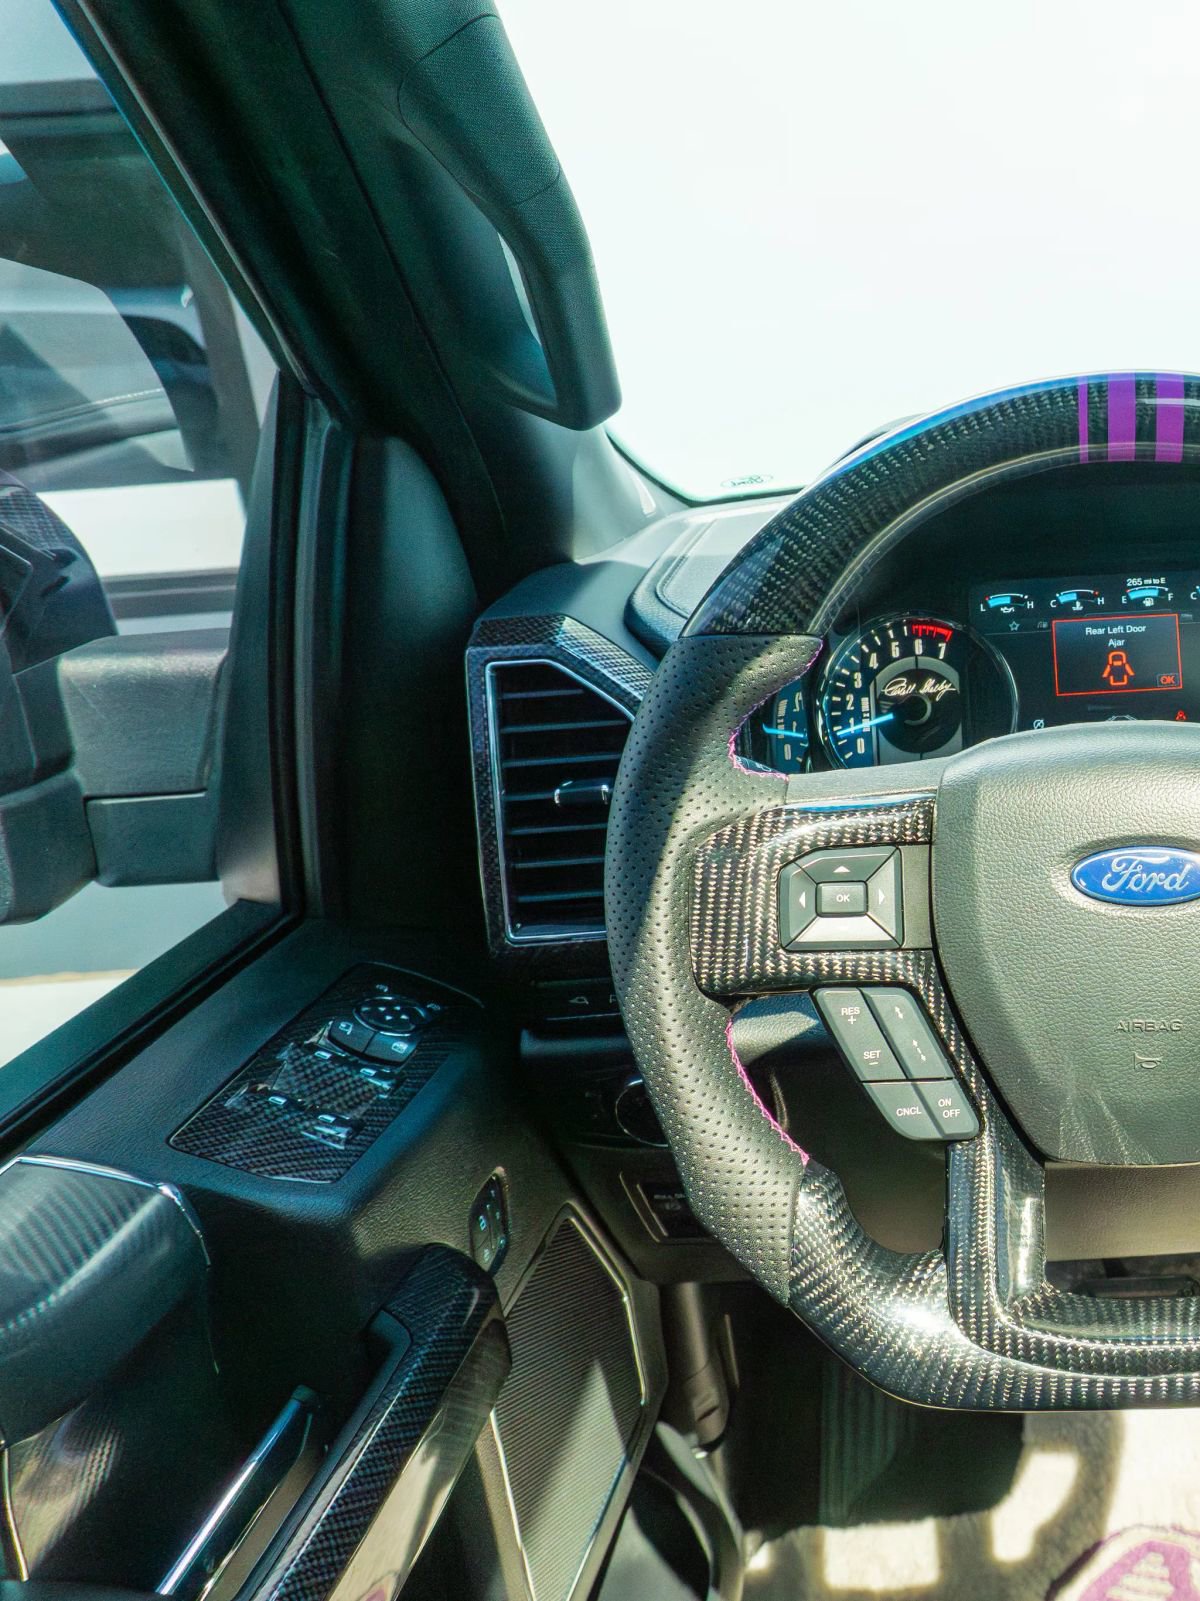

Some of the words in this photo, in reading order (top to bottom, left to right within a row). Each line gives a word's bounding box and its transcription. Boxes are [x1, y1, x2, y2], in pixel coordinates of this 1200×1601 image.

[1126, 578, 1143, 586] 265
[1121, 595, 1127, 604] E
[1167, 593, 1174, 601] F
[1190, 591, 1197, 600] C
[1027, 601, 1034, 609] H
[1050, 600, 1057, 608] C
[1097, 597, 1105, 605] H
[980, 604, 986, 612] L
[1085, 627, 1105, 636] Rear
[1107, 625, 1124, 634] Left
[1126, 624, 1146, 633] Door
[914, 638, 923, 655] 6
[1108, 639, 1125, 648] Ajar
[891, 641, 900, 658] 5
[937, 642, 947, 660] 7
[869, 653, 879, 669] 4
[854, 672, 862, 688] 3
[1160, 675, 1176, 685] OK
[919, 678, 957, 702] Shelby
[846, 694, 854, 710] 2
[849, 717, 855, 734] 1
[857, 737, 865, 754] 0
[1101, 855, 1191, 893] Ford
[836, 893, 850, 903] OK
[841, 1006, 860, 1016] RES
[1114, 1020, 1184, 1033] AIRBAG
[863, 1050, 881, 1060] SET
[938, 1098, 952, 1107] ON
[896, 1106, 922, 1118] CNCL
[942, 1108, 961, 1118] OFF
